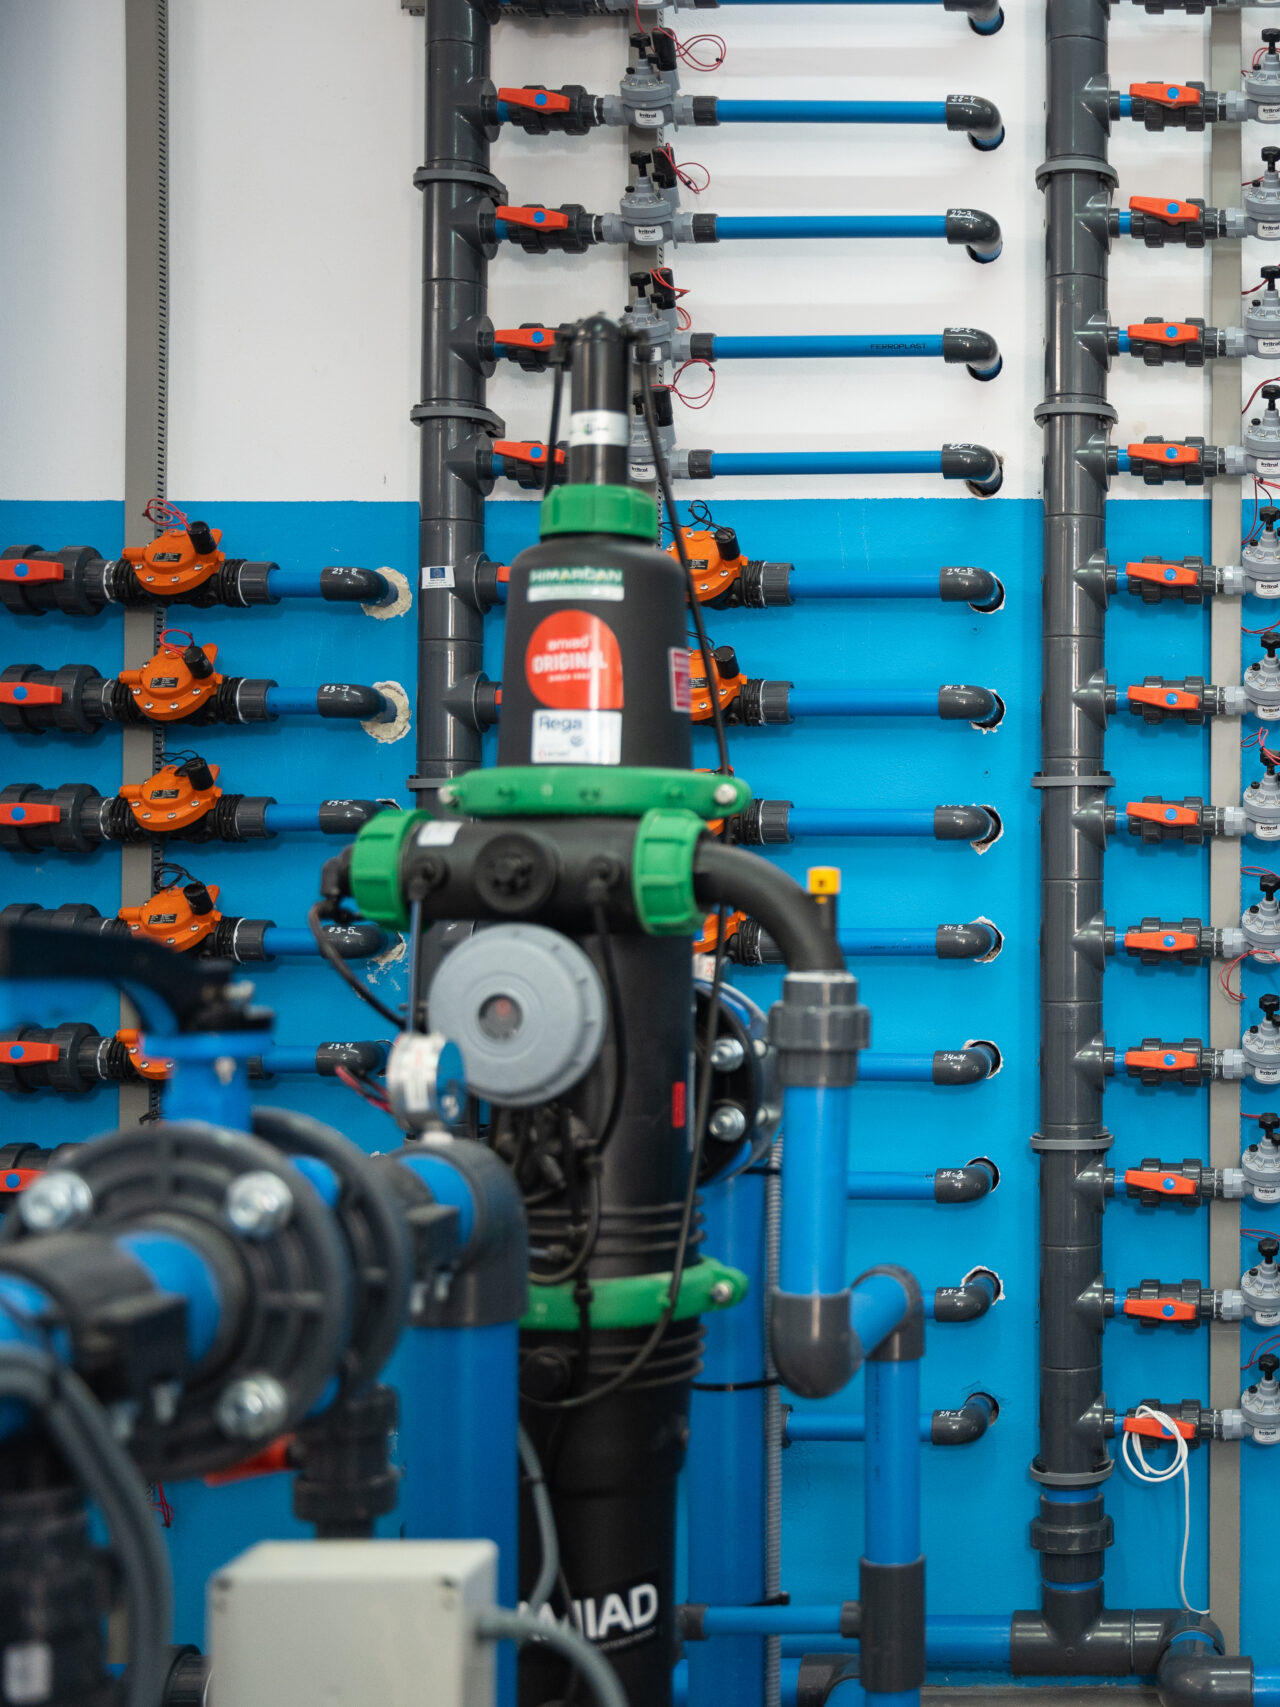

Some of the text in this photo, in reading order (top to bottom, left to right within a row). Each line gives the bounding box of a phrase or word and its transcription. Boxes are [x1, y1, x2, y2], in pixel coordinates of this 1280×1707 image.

[951, 210, 972, 218] 22-3
[332, 567, 358, 576] 23-8
[530, 567, 623, 583] HIMARCAN
[946, 568, 974, 576] 24-8
[532, 651, 608, 675] ORIGINAL
[538, 715, 583, 731] Rega
[942, 1053, 966, 1062] 24-4
